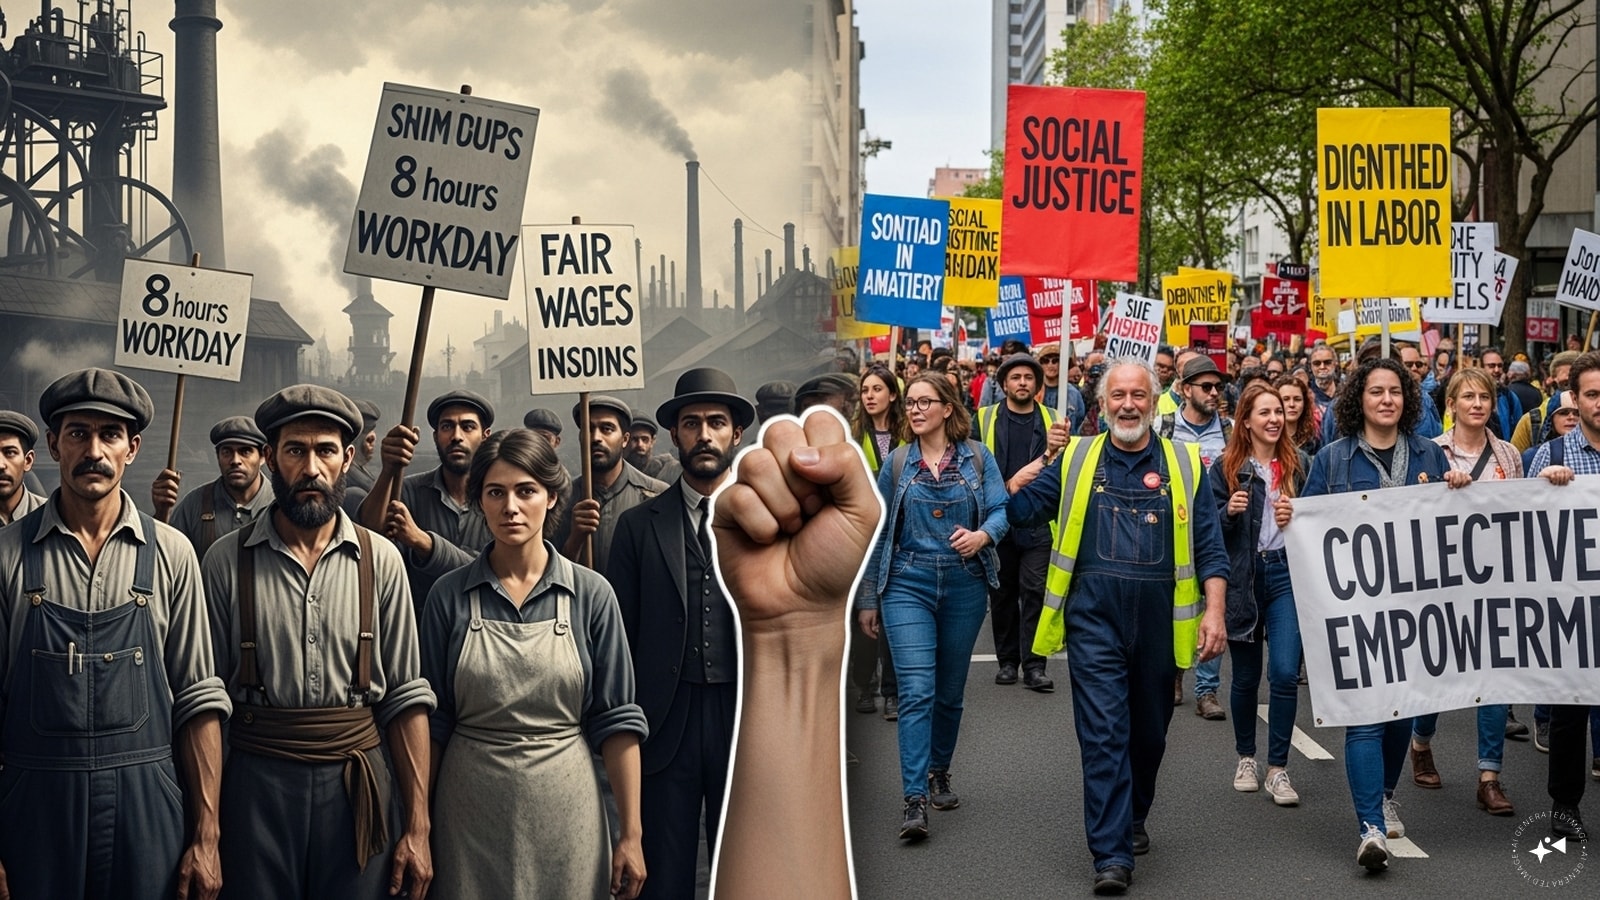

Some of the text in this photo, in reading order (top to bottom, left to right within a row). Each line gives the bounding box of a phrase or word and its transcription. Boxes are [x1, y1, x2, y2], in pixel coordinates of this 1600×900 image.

[1021, 115, 1128, 165] SOCIAL
[390, 155, 498, 211] 8 hours
[1012, 165, 1136, 215] JUSTICE
[1323, 143, 1448, 191] DIGNTHED
[358, 210, 519, 276] WORKDAY
[1327, 199, 1442, 247] IN LABOR
[540, 233, 613, 276] FAIR
[895, 243, 914, 271] IN
[1450, 251, 1483, 279] ITY
[142, 273, 229, 324] 8 hours
[534, 283, 634, 329] WAGES
[122, 318, 242, 366] WORKDAY
[537, 345, 639, 380] INSDINS
[1323, 508, 1600, 601] COLLECTIVE
